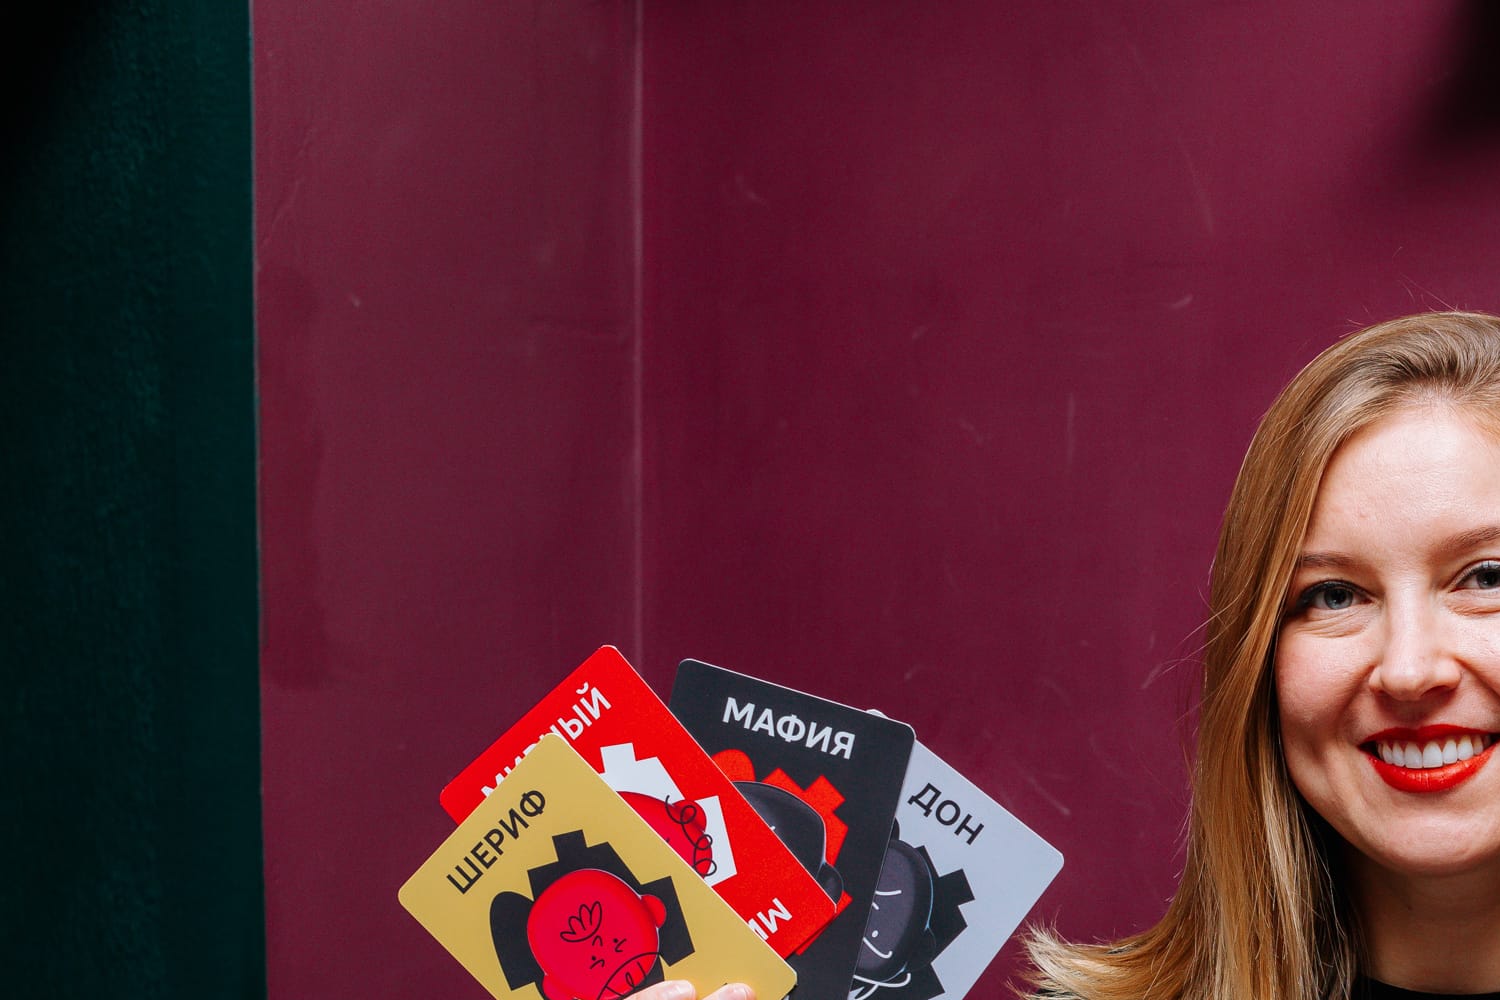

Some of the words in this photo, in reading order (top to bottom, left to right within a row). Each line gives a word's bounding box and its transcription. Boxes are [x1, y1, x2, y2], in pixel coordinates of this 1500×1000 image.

[722, 696, 856, 760] МАФИЯ
[446, 789, 546, 895] ШЕРИФ
[907, 782, 985, 846] ДОН
